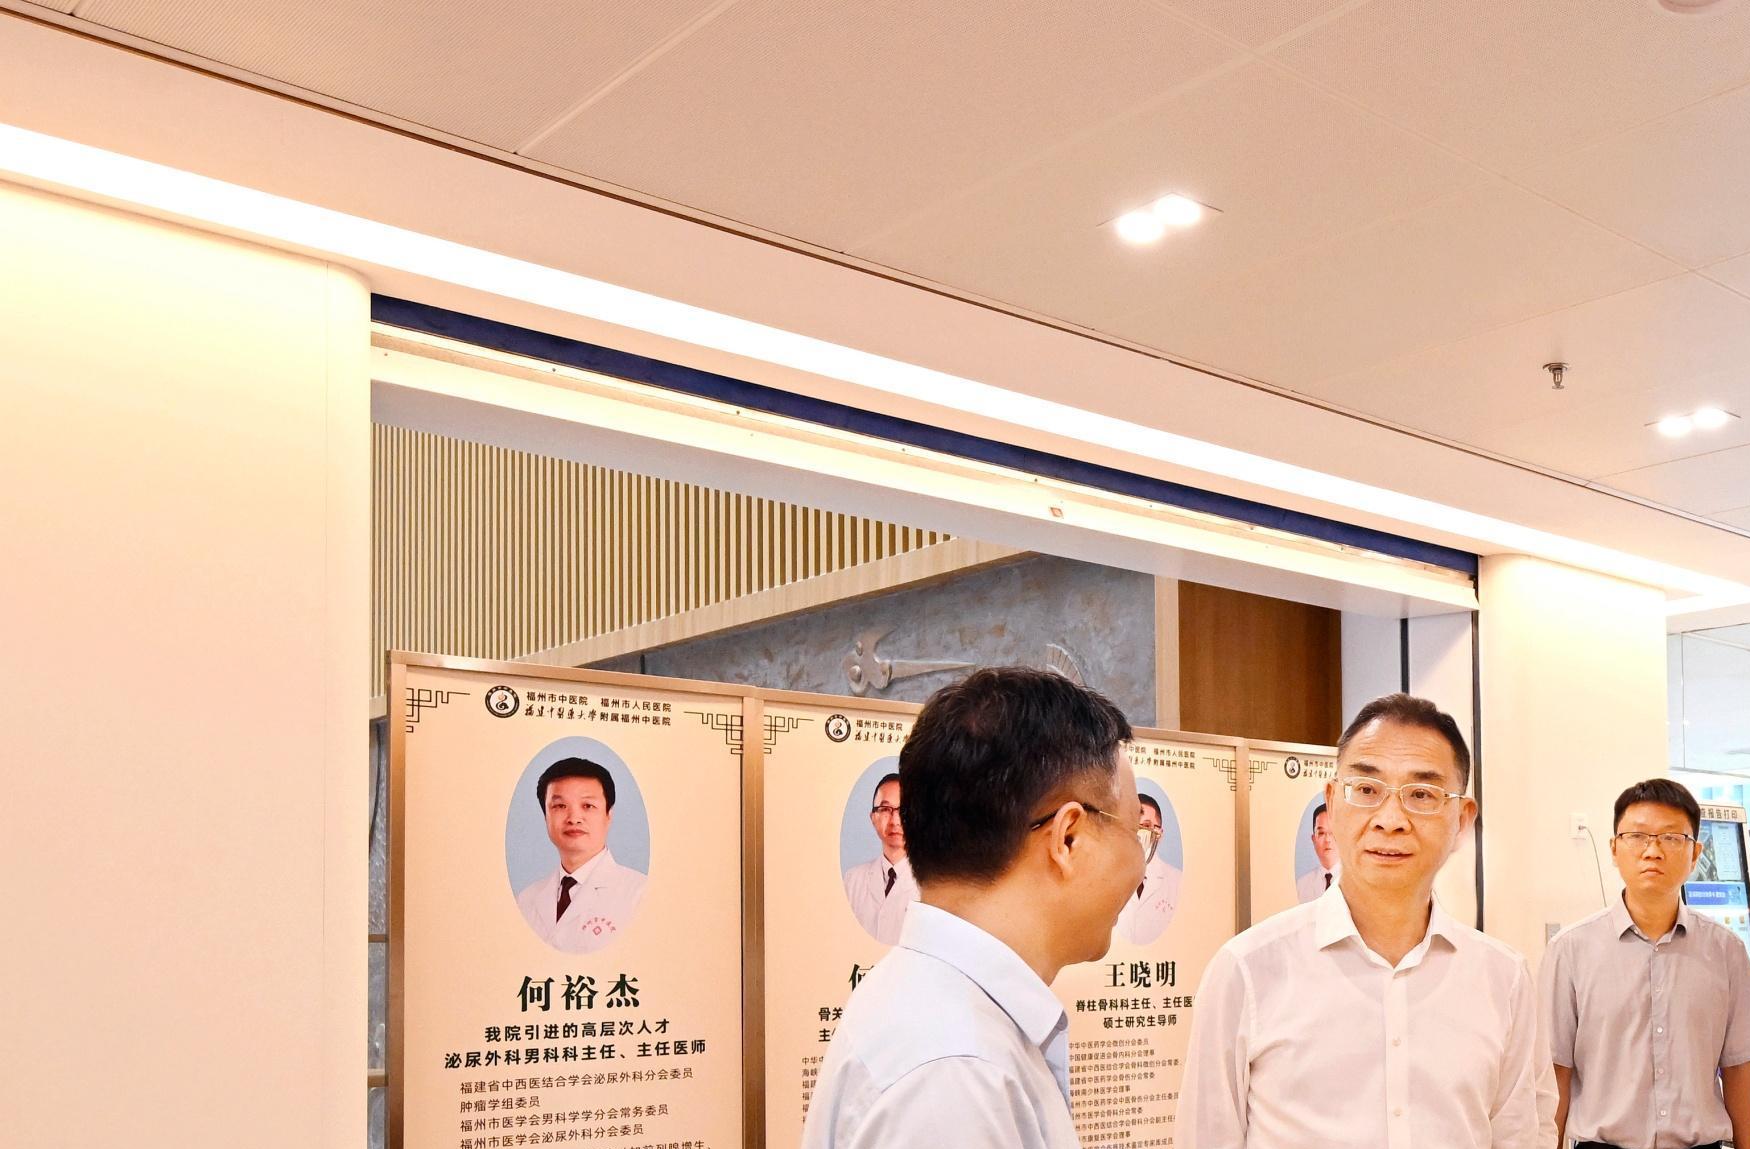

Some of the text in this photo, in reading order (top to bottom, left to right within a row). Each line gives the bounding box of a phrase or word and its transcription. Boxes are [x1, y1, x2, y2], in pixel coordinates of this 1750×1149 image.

[526, 691, 588, 707] 福州市中医院
[600, 697, 671, 713] 福州市人民医院
[1104, 960, 1177, 989] 王晓明
[516, 973, 640, 1012] 何裕杰
[1075, 995, 1195, 1013] 脊柱骨科科主任、主任医
[484, 1018, 670, 1043] 我院引进的高层次人才
[1103, 1014, 1177, 1029] 硕士研究生导师
[818, 1028, 836, 1042] 主
[444, 1039, 707, 1069] 泌尿外科男科科主任、主任医师
[460, 1067, 694, 1095] 福建省中西医结合学会泌尿外科分会委员
[460, 1096, 540, 1113] 肿瘤学组委员
[460, 1104, 669, 1133] 福州市医学会男科学学分会常务委员
